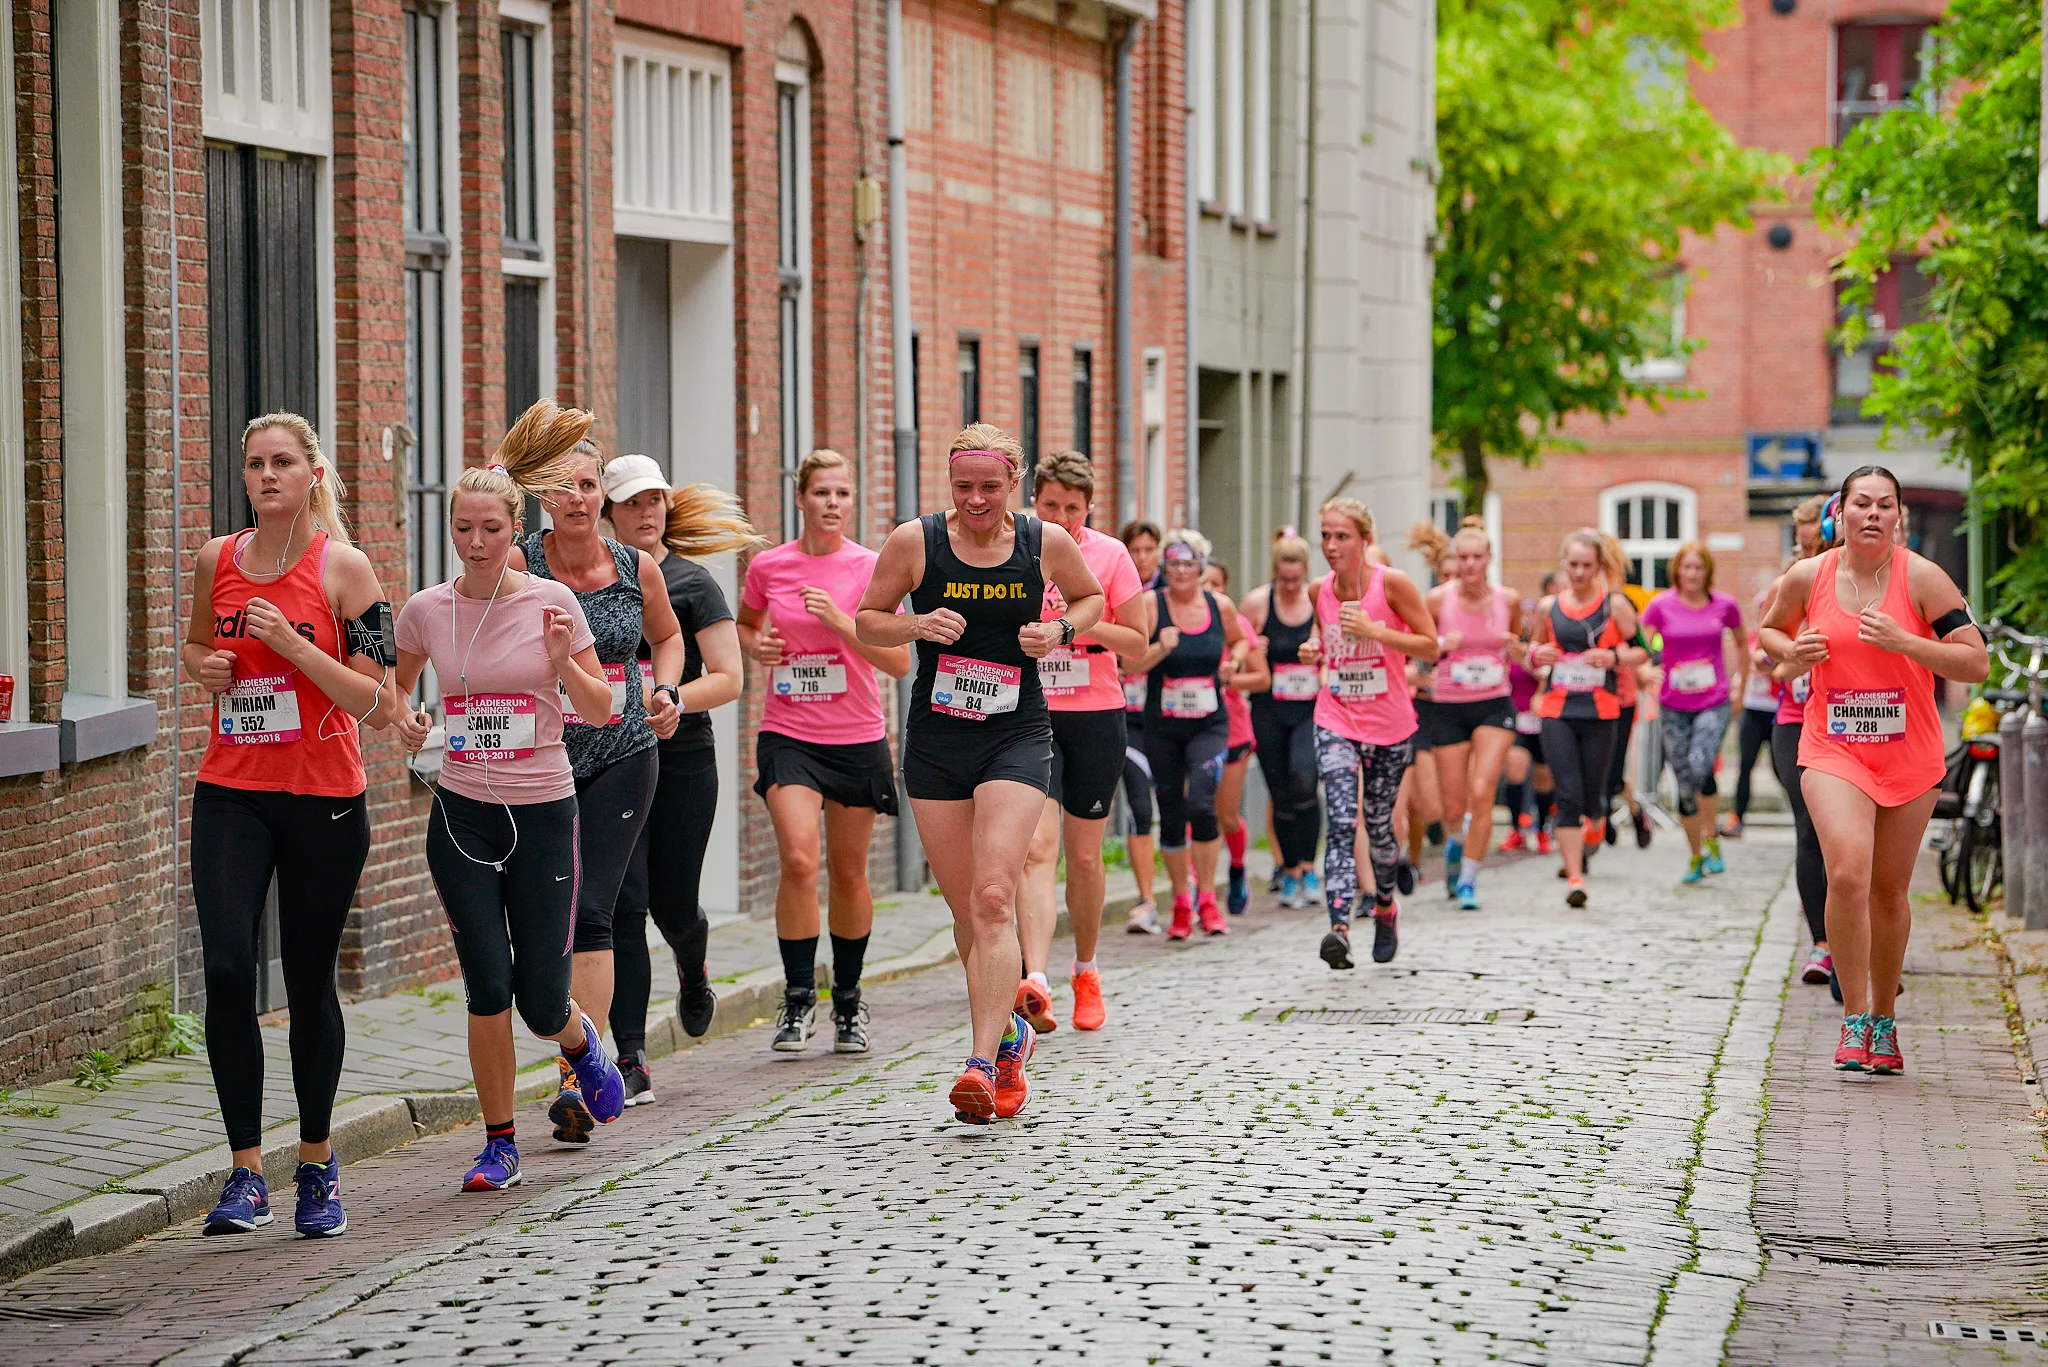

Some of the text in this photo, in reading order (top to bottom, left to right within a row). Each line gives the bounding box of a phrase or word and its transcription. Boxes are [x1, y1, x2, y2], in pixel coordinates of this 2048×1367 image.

[943, 582, 1027, 600] JUST DO IT.
[792, 667, 827, 678] TINEKE
[955, 668, 1002, 683] GRONINGEN
[967, 663, 1014, 678] LADIESRUN
[237, 676, 285, 688] LADIESRUN
[1051, 675, 1056, 685] 7
[230, 685, 273, 696] GRONINGEN
[801, 681, 819, 692] 716
[954, 676, 999, 697] RENATE
[1855, 691, 1898, 699] LADIESRUN
[231, 695, 276, 712] MIRIAM
[476, 699, 526, 707] LADIESRUN
[965, 696, 982, 711] 84
[1833, 705, 1900, 718] CHARMAINE
[241, 715, 265, 732] 552
[468, 716, 509, 730] SANNE
[1855, 721, 1878, 733] 288
[234, 733, 280, 744] 10-06-2018
[475, 734, 501, 749] 383
[1845, 735, 1889, 743] 10-06-2018
[465, 752, 515, 760] 10-06-2018
